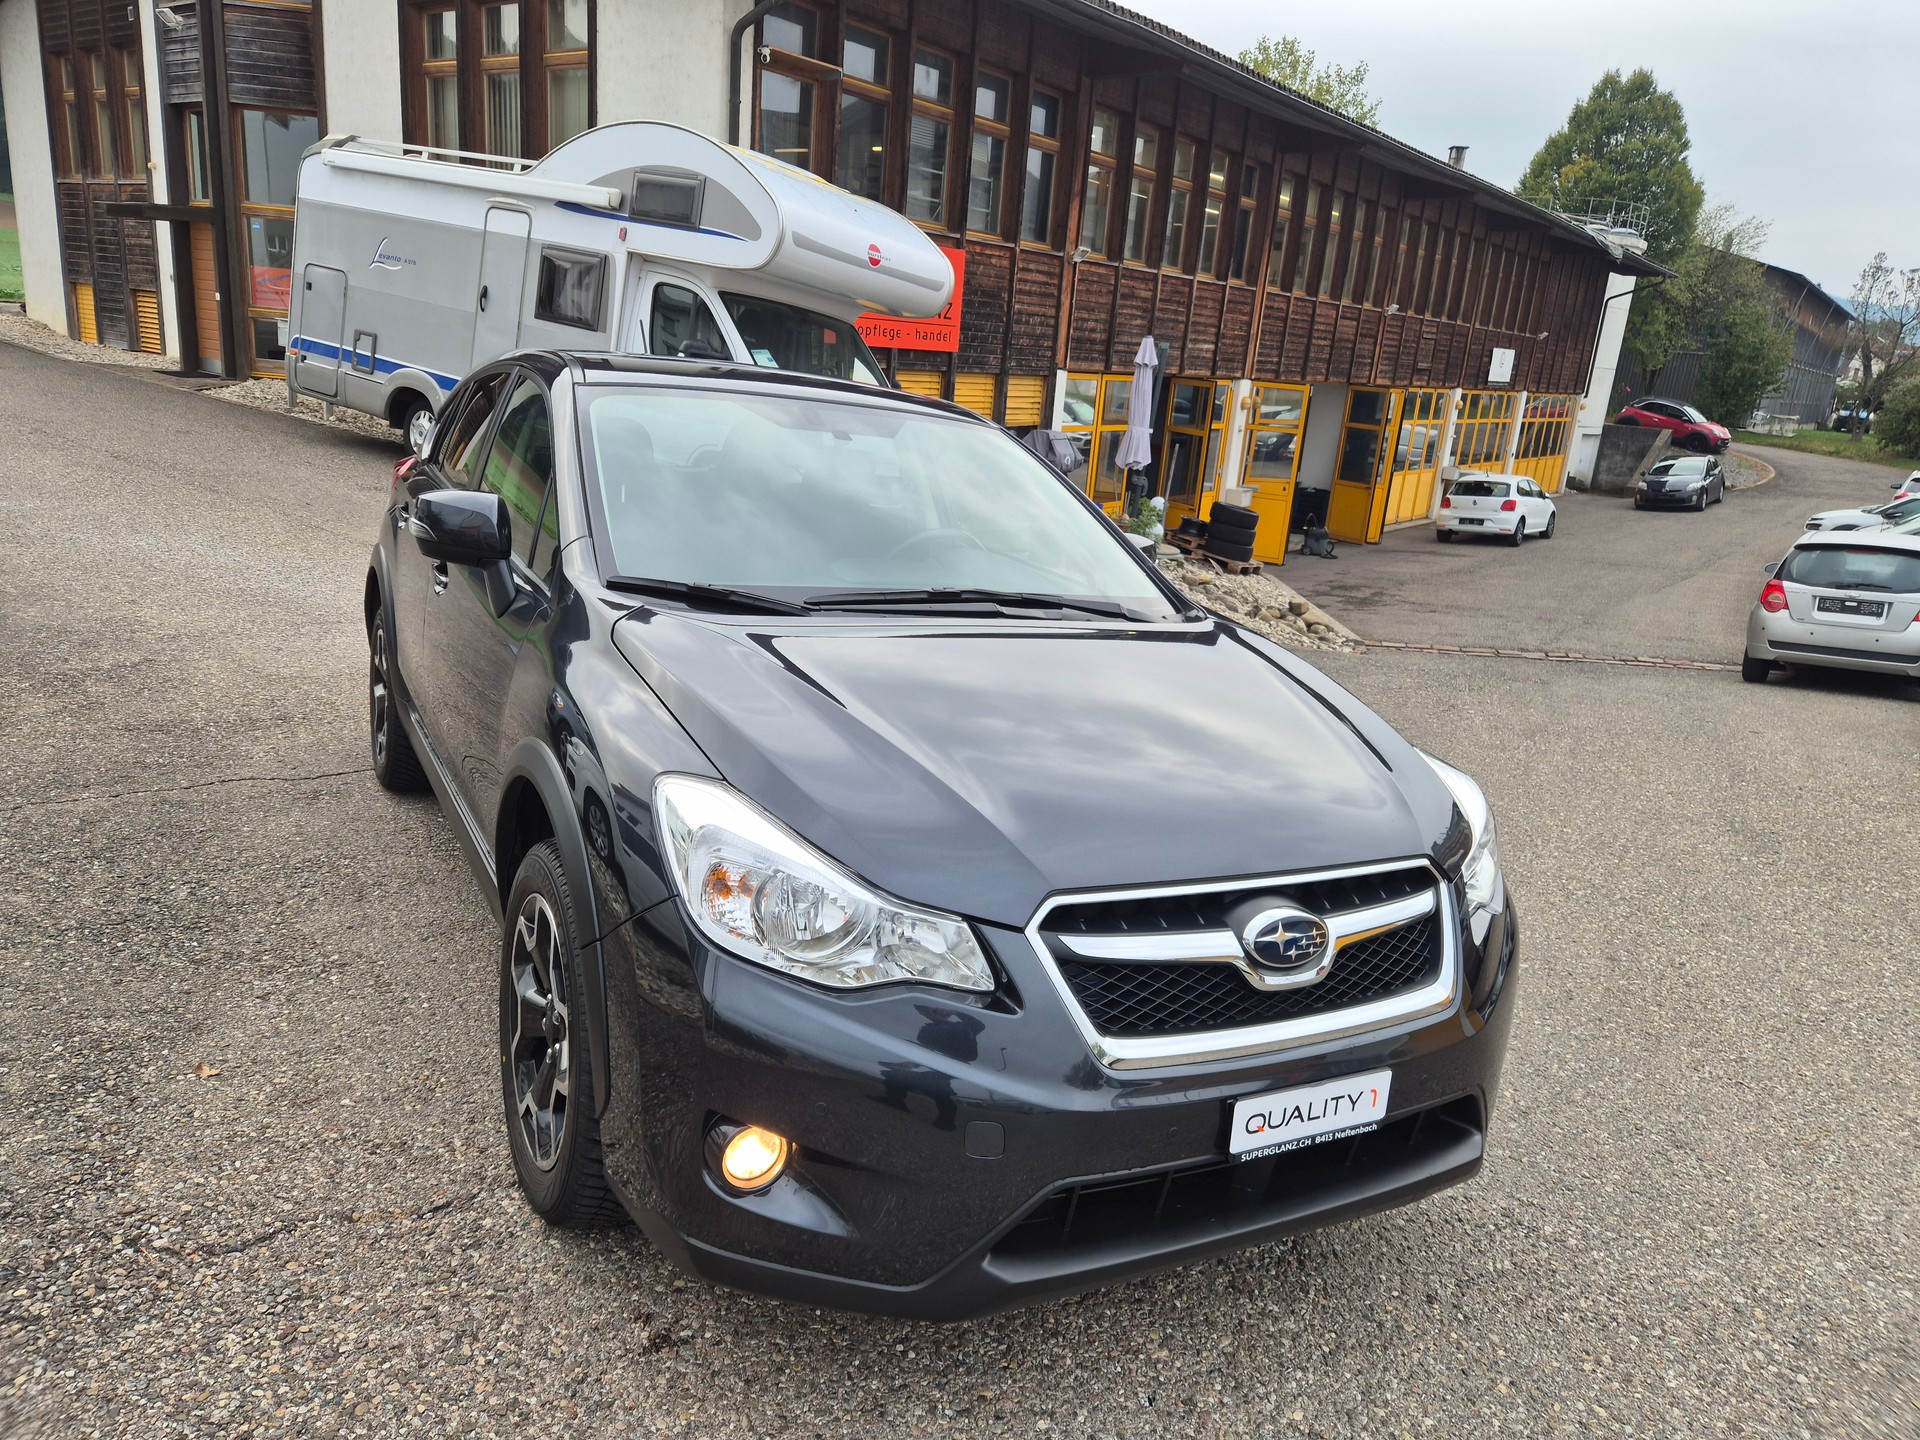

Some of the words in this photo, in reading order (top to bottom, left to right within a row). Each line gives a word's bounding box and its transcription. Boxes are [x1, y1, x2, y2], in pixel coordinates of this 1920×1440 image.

[915, 328, 952, 342] handel
[1240, 1138, 1312, 1162] SUPERGLANZ.CH
[1315, 1133, 1333, 1144] 8413
[1335, 1123, 1377, 1140] Neftenbach
